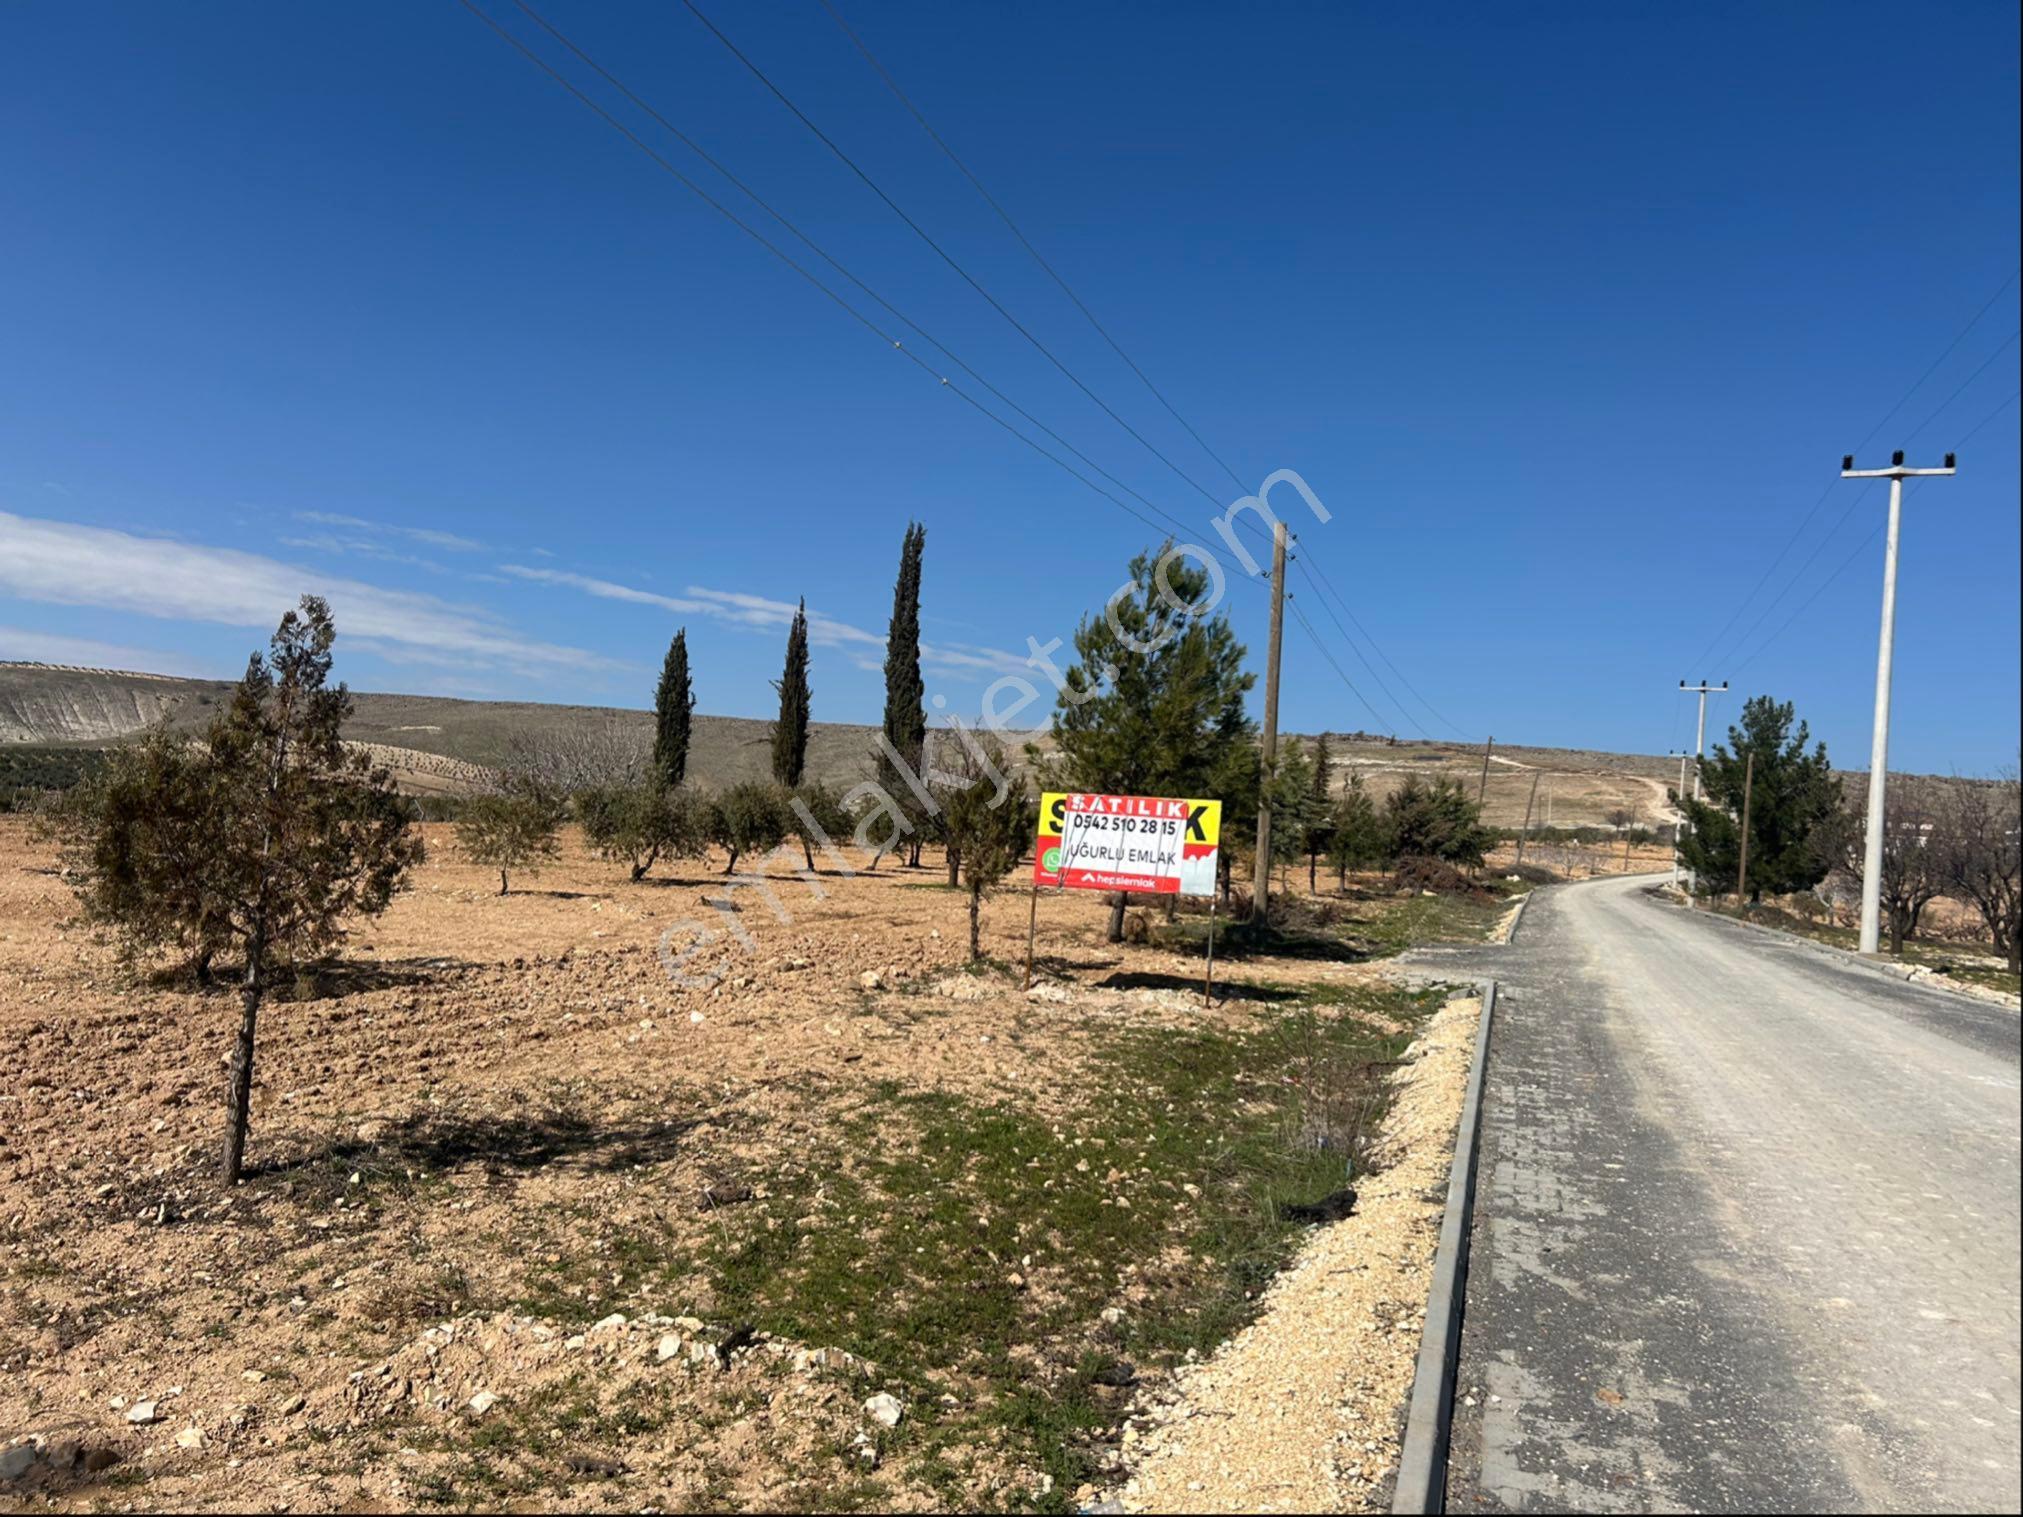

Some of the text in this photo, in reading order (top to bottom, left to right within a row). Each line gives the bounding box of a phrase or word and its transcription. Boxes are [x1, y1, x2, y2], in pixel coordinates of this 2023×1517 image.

[1071, 795, 1183, 817] SATILIK
[1074, 814, 1108, 830] 0542
[1112, 817, 1136, 832] 510
[1140, 819, 1157, 834] 28
[1162, 821, 1176, 836] 15
[1070, 842, 1176, 865] UĞURLU EMLAK
